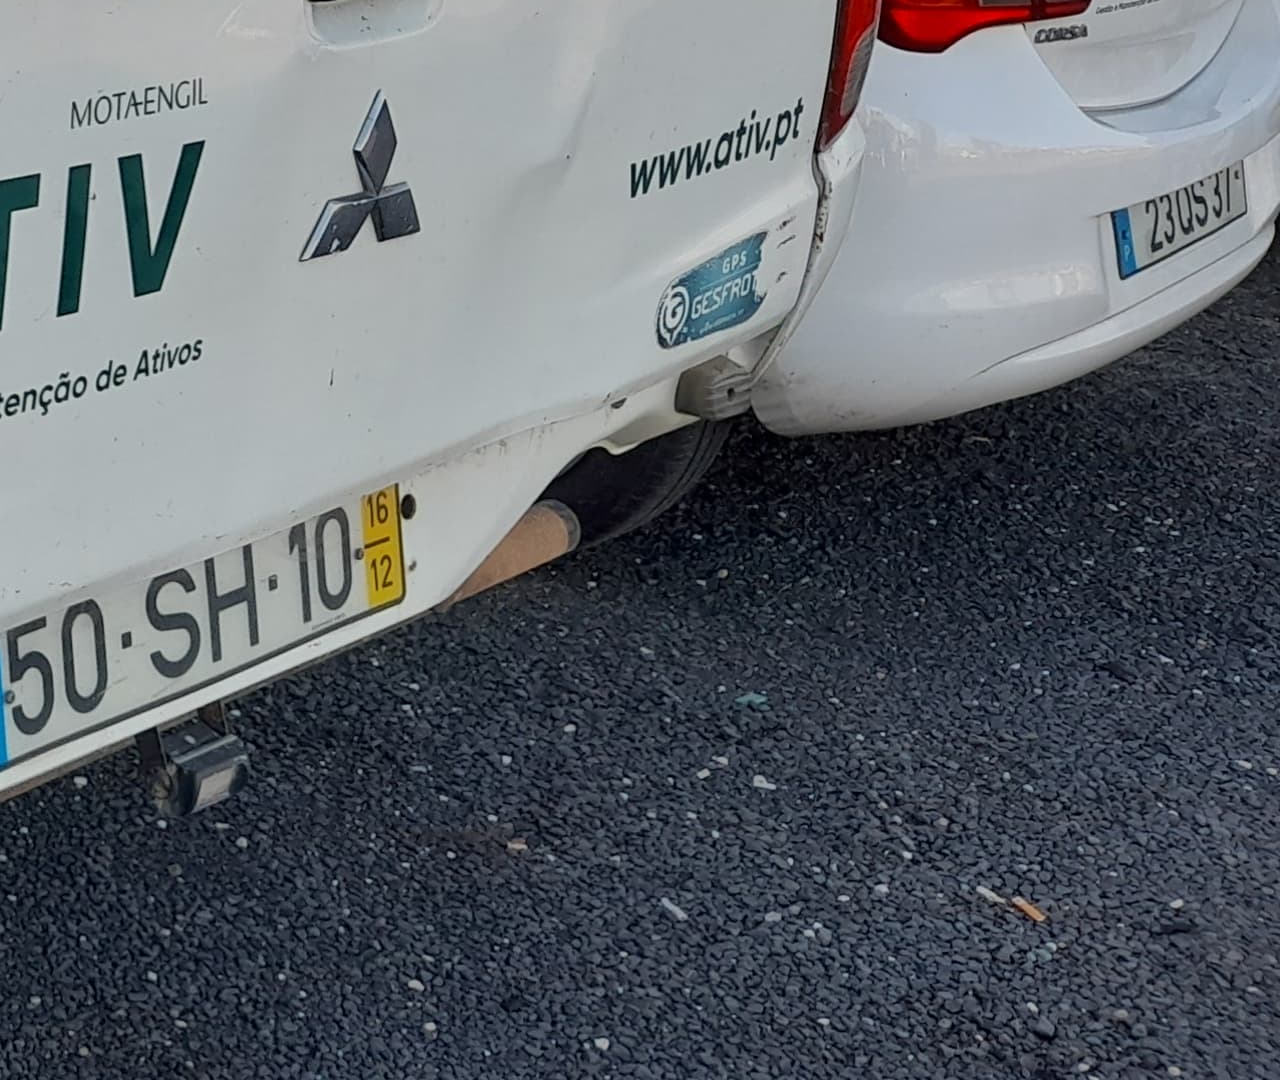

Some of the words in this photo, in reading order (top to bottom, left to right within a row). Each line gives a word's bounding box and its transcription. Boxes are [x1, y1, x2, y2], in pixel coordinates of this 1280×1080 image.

[629, 96, 804, 199] www.ativ.pt
[722, 250, 748, 275] GPS
[95, 360, 128, 392] de
[133, 337, 204, 382] Ativos
[366, 490, 389, 528] 16
[370, 554, 394, 592] 12
